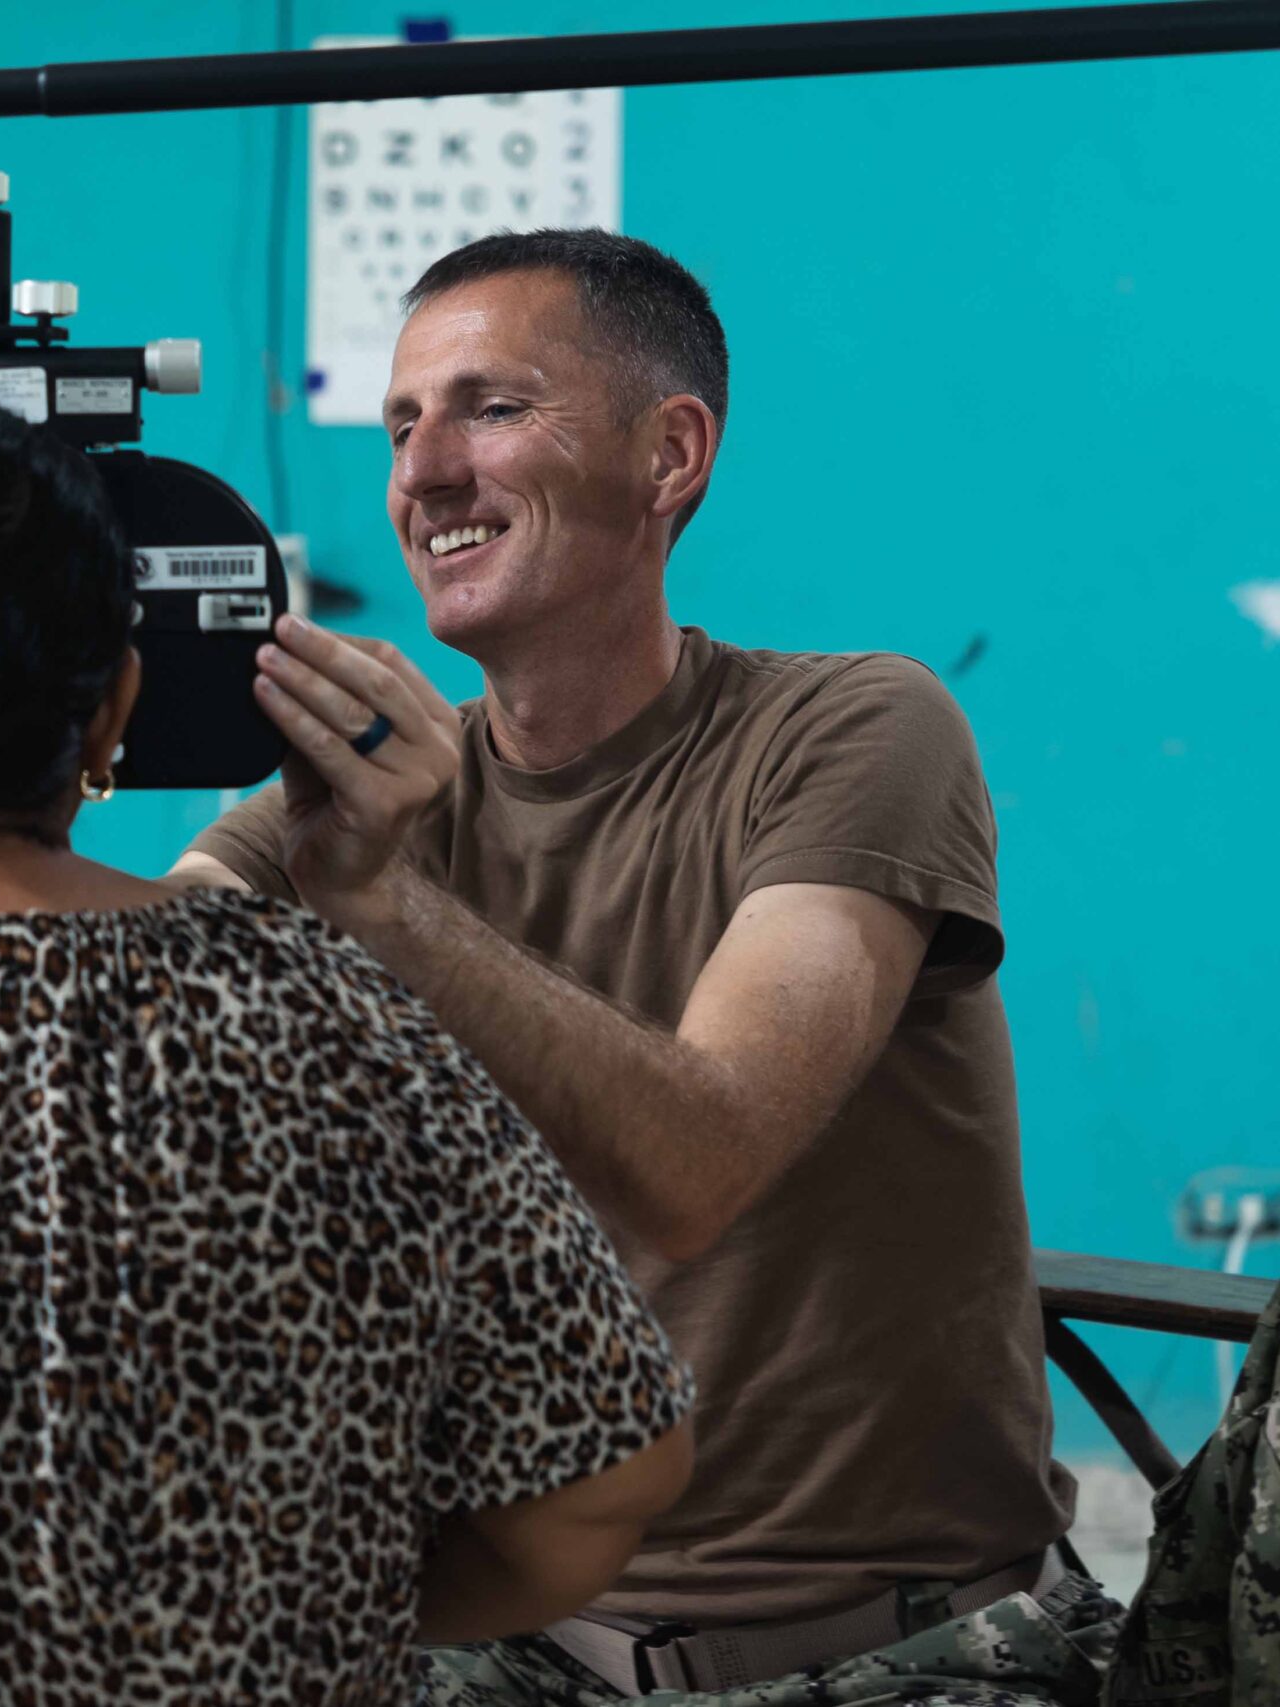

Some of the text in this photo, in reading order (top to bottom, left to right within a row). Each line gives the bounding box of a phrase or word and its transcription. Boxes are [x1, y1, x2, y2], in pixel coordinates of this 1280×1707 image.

[381, 129, 418, 168] Z
[439, 128, 477, 168] K
[499, 130, 537, 169] O
[1142, 1650, 1206, 1687] U.S.
